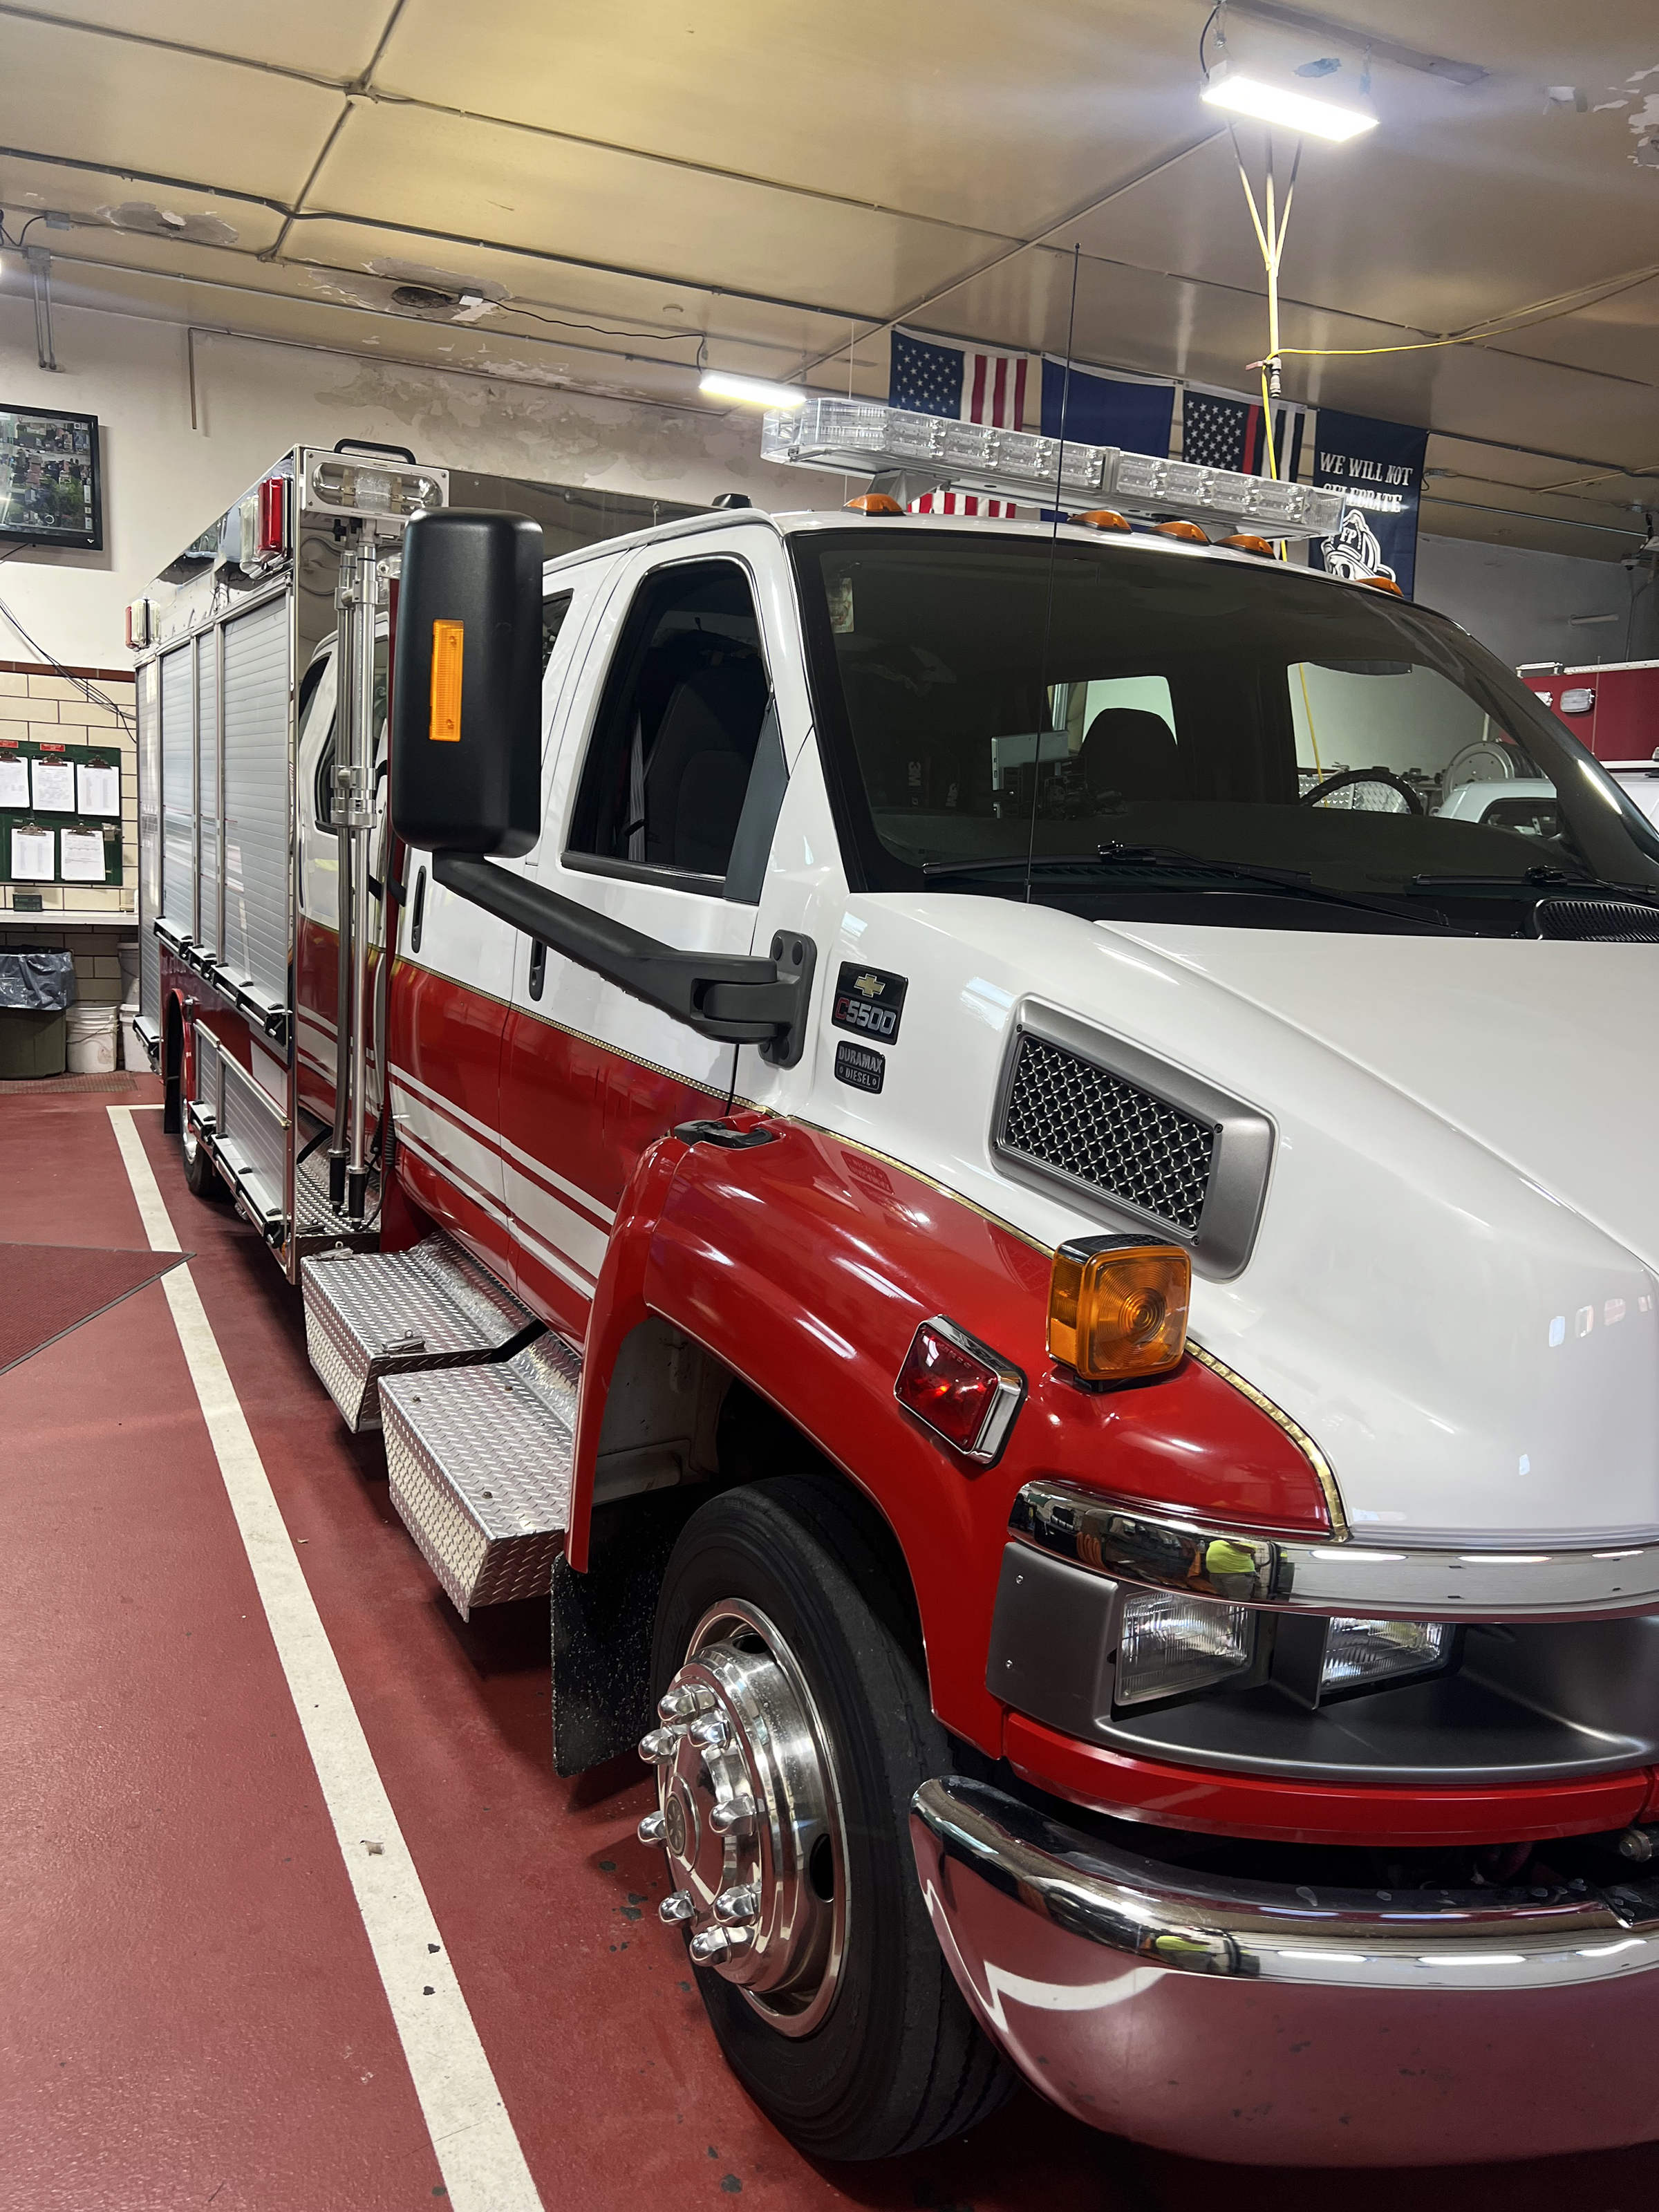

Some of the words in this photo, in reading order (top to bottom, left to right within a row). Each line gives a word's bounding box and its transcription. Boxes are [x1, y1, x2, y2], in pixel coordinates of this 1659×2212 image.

[1320, 451, 1346, 475] WE
[1349, 457, 1382, 482] WILL
[1385, 465, 1414, 486] NOT
[1340, 527, 1358, 544] FP
[908, 761, 921, 787] 3M
[835, 997, 897, 1035] C5500
[838, 1045, 883, 1074] DURAMAX
[845, 1067, 871, 1086] DIESEL
